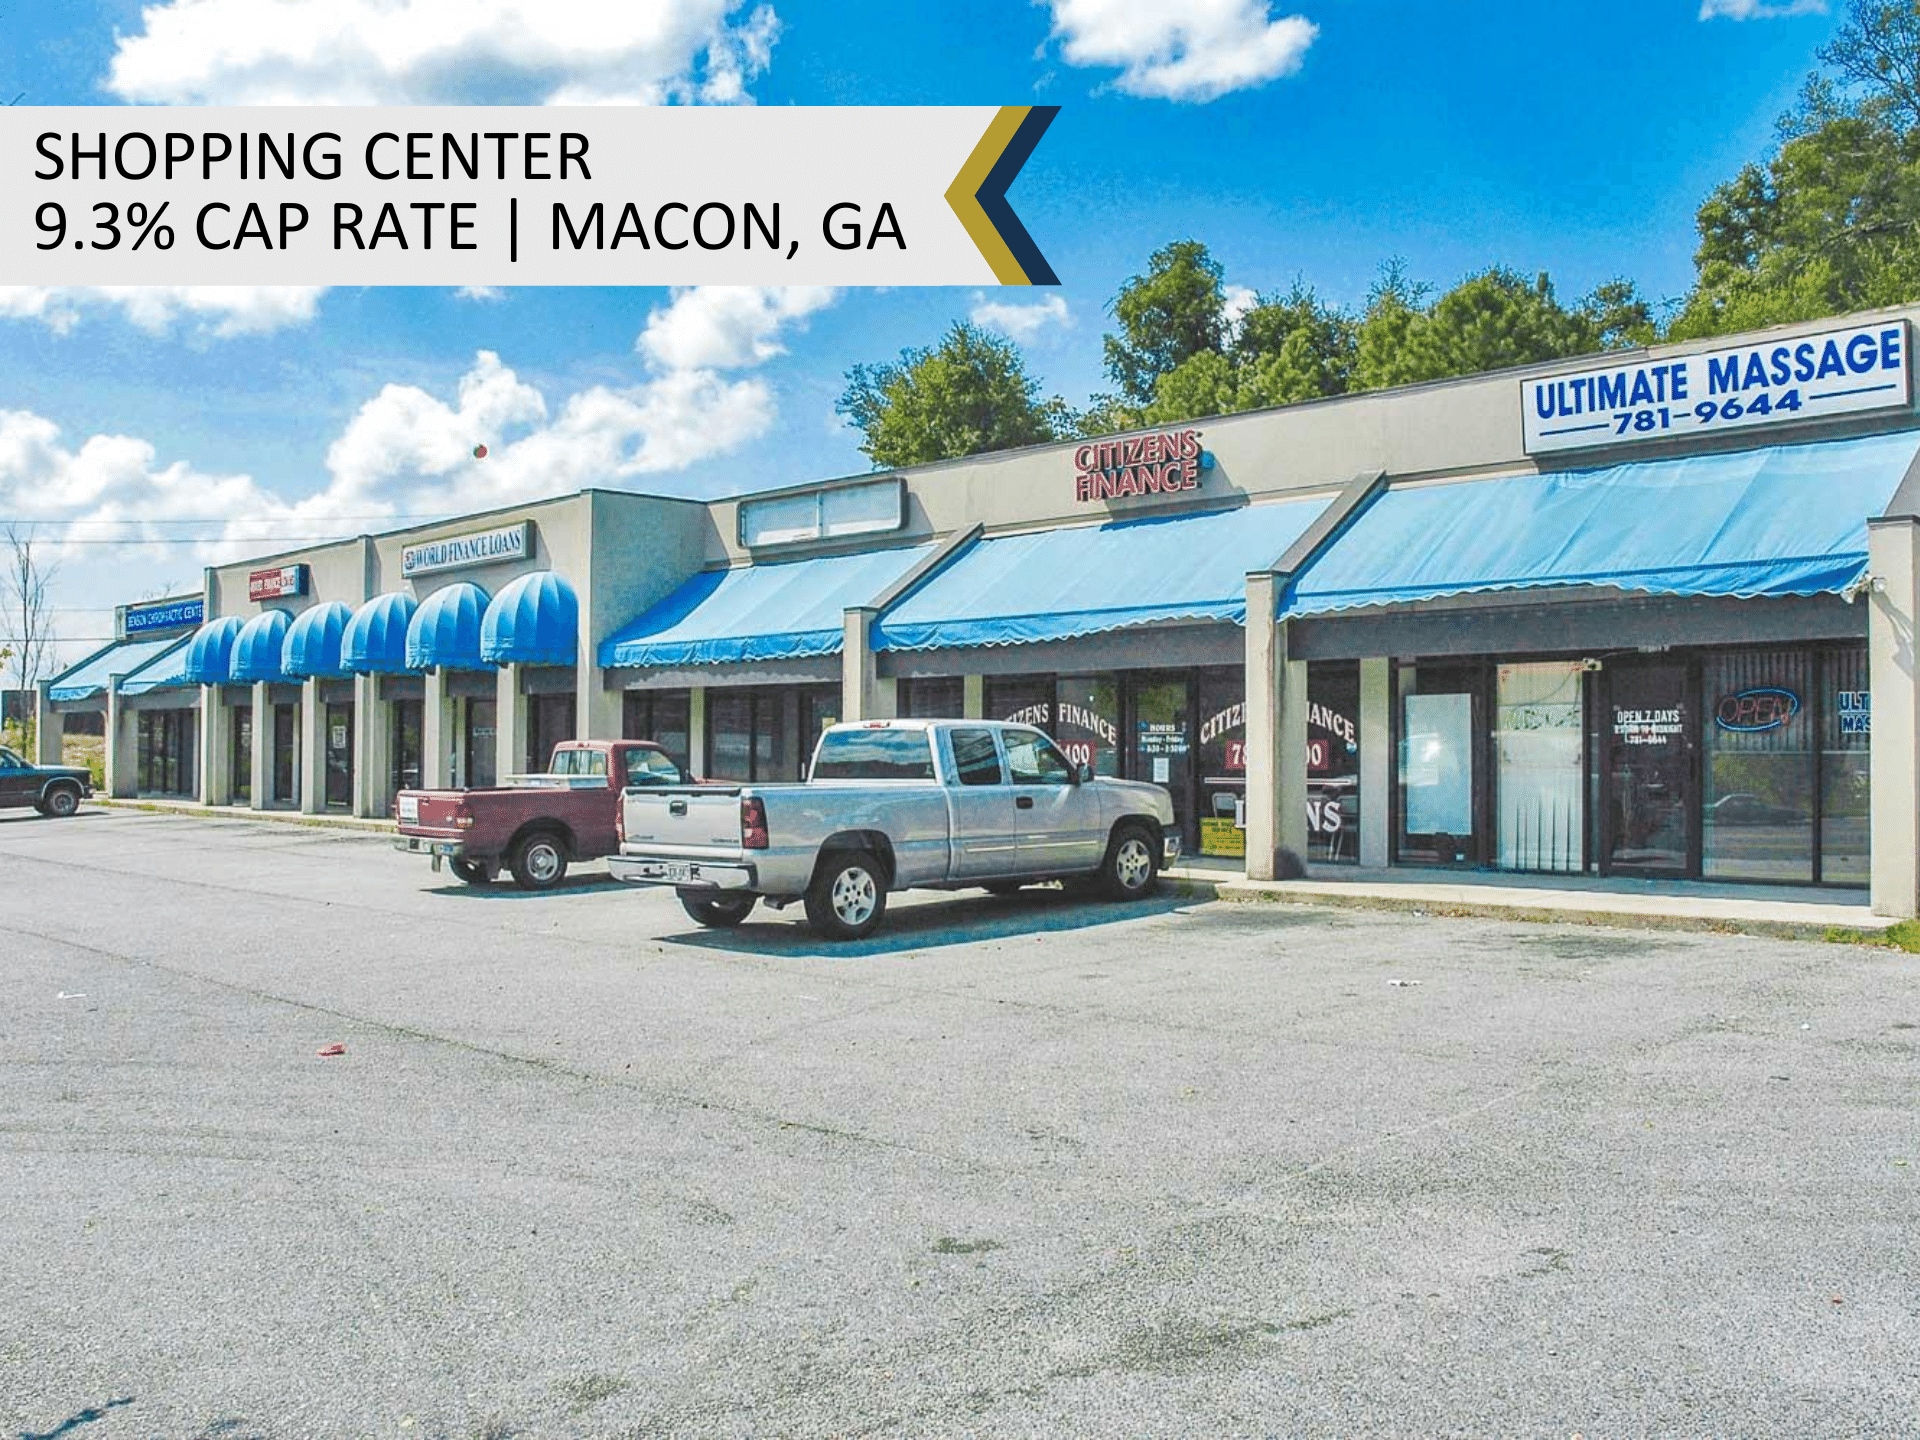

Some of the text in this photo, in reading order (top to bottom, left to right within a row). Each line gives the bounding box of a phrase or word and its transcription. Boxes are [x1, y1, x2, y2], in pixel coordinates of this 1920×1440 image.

[1536, 329, 1900, 420] ULTIMATE MASSAGE
[1613, 390, 1802, 435] 781-9644
[1075, 429, 1199, 472] CITIZENS
[1076, 459, 1198, 501] FINANCE
[415, 529, 520, 566] WORLD FINANCE LOANS
[184, 604, 204, 619] CENTE
[1059, 703, 1117, 746] FINANCE
[1200, 702, 1355, 745] CITIZ ANCE
[1617, 710, 1680, 723] OPEN 7 DAYS
[1719, 696, 1790, 724] OPEN
